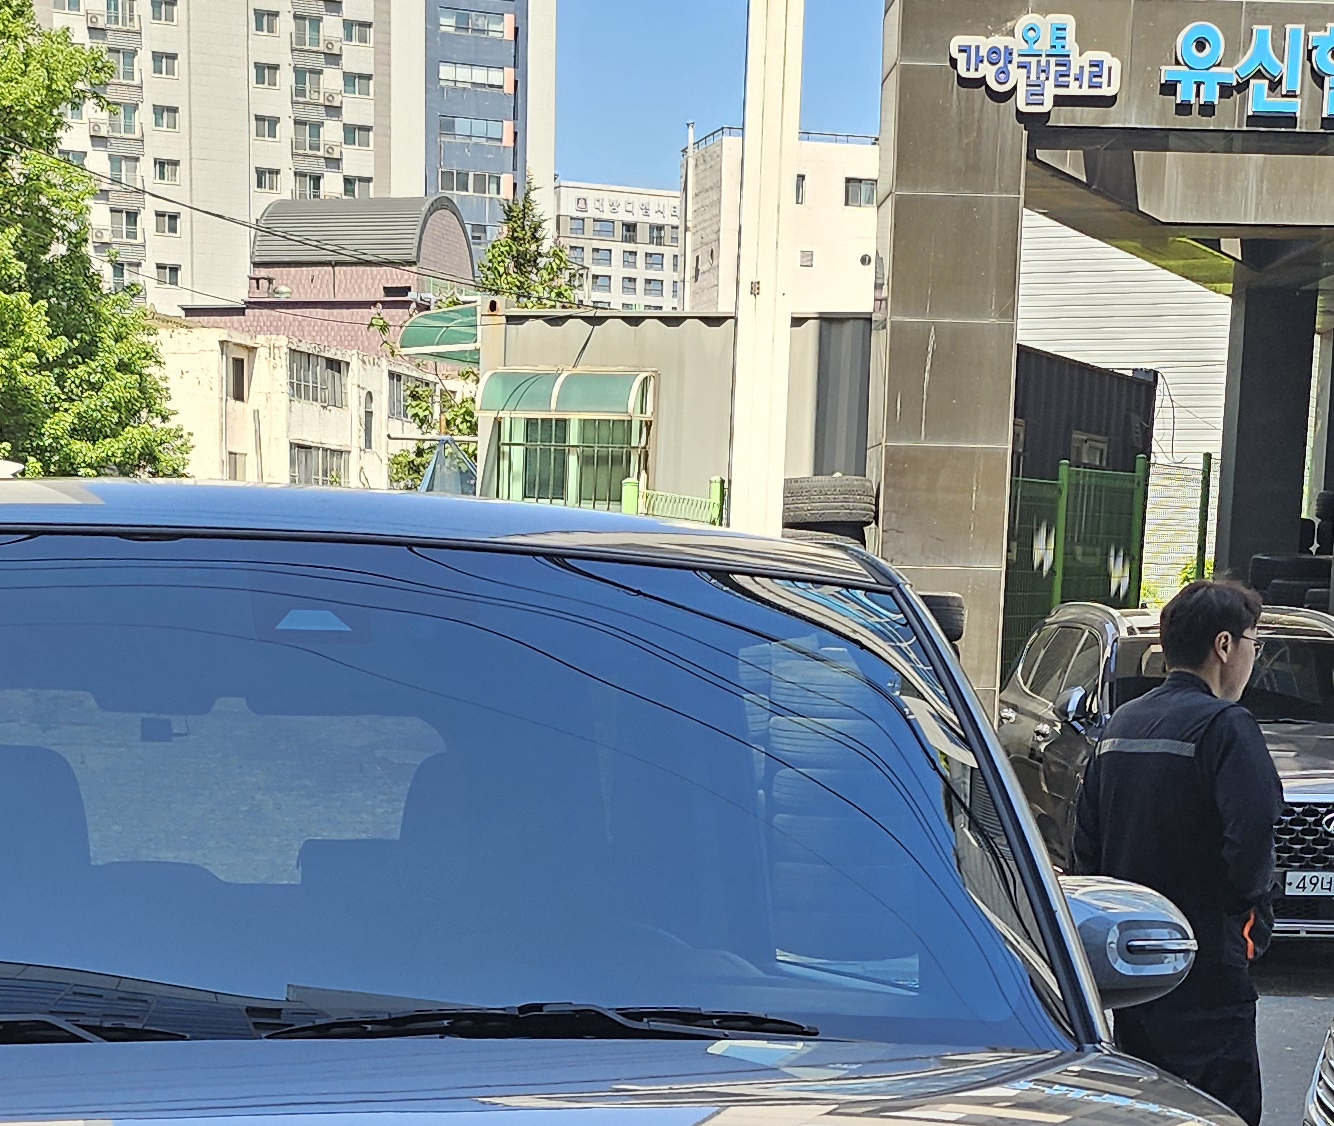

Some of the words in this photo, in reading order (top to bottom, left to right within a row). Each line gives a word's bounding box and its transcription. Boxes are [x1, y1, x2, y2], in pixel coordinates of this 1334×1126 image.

[1017, 22, 1072, 57] 오토
[957, 44, 1014, 85] 가양
[1017, 58, 1113, 107] 갤러리
[1295, 874, 1333, 894] 49너
